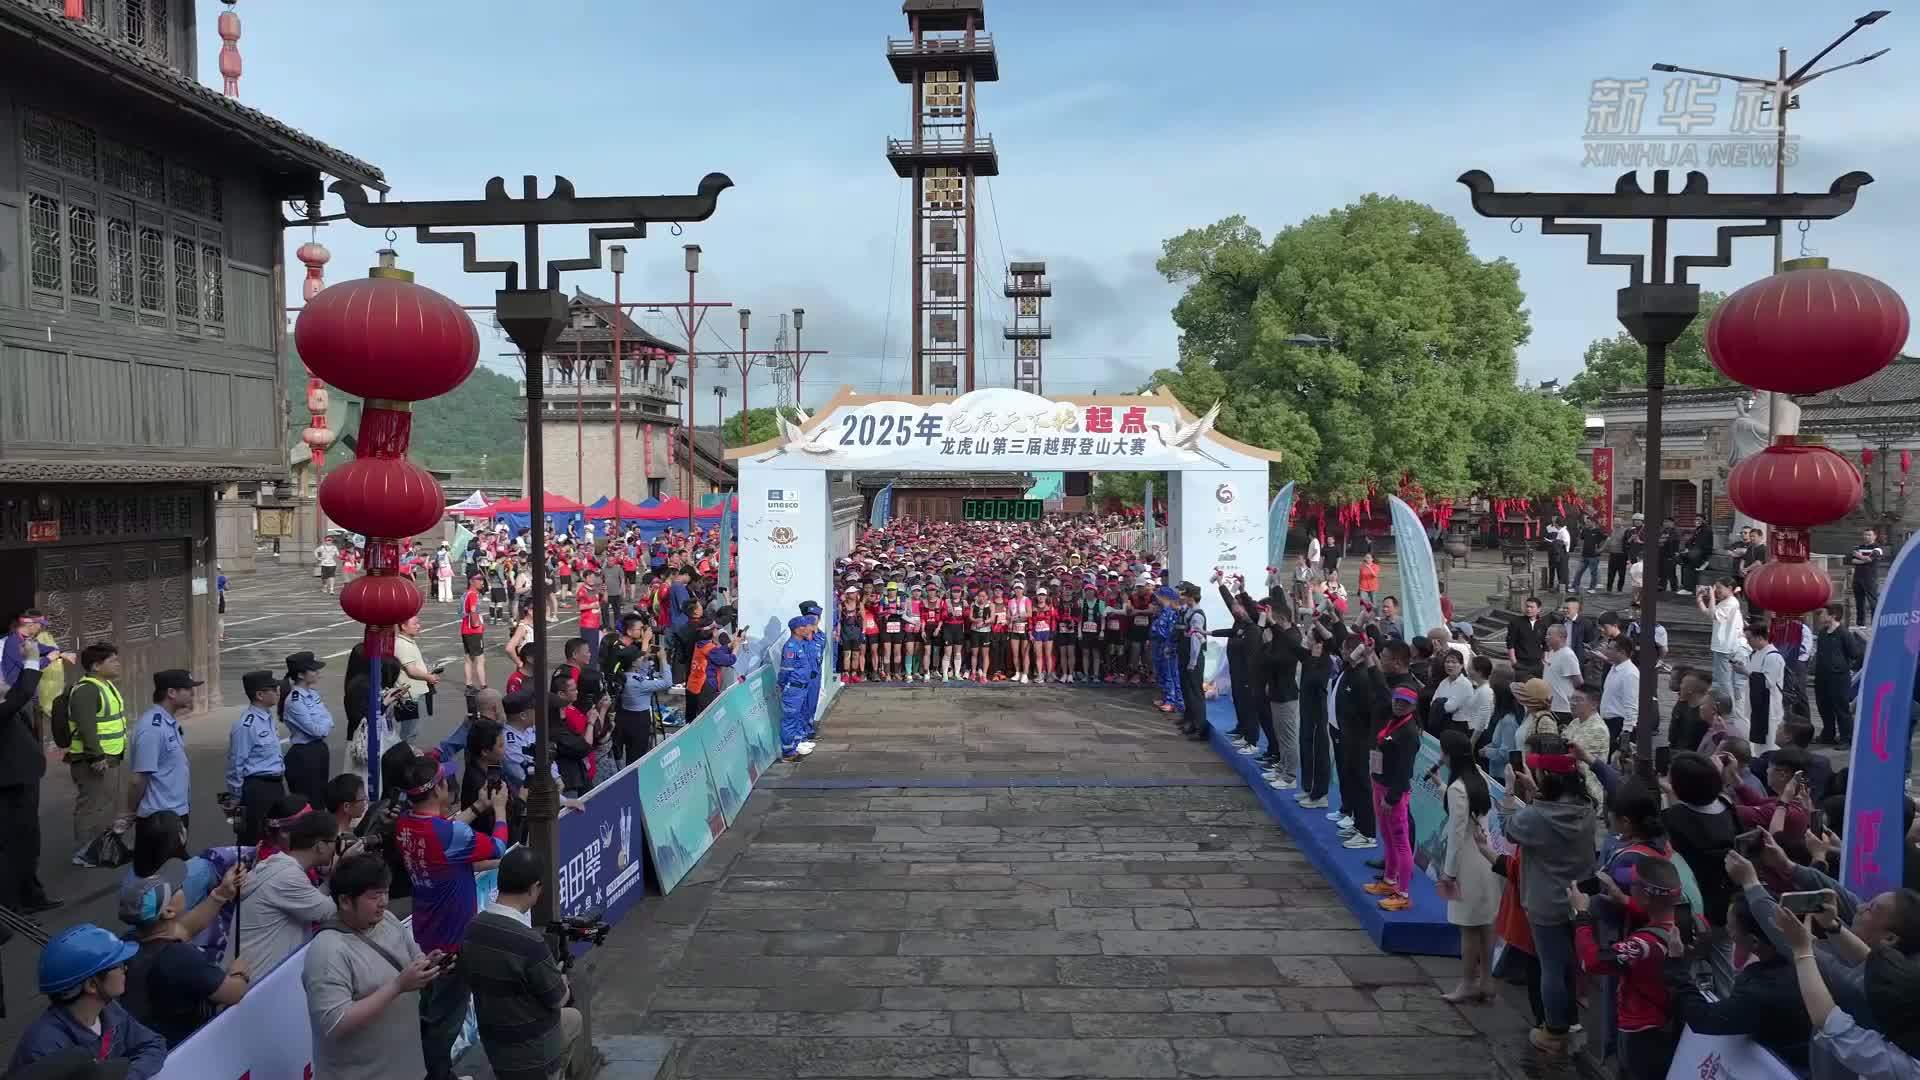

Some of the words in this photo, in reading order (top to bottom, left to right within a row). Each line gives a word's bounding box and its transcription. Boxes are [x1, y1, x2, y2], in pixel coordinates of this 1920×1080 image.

[839, 412, 943, 446] 2025年
[1085, 406, 1148, 434] 起点
[939, 437, 1147, 456] 龙虎山第三届越野登山大赛
